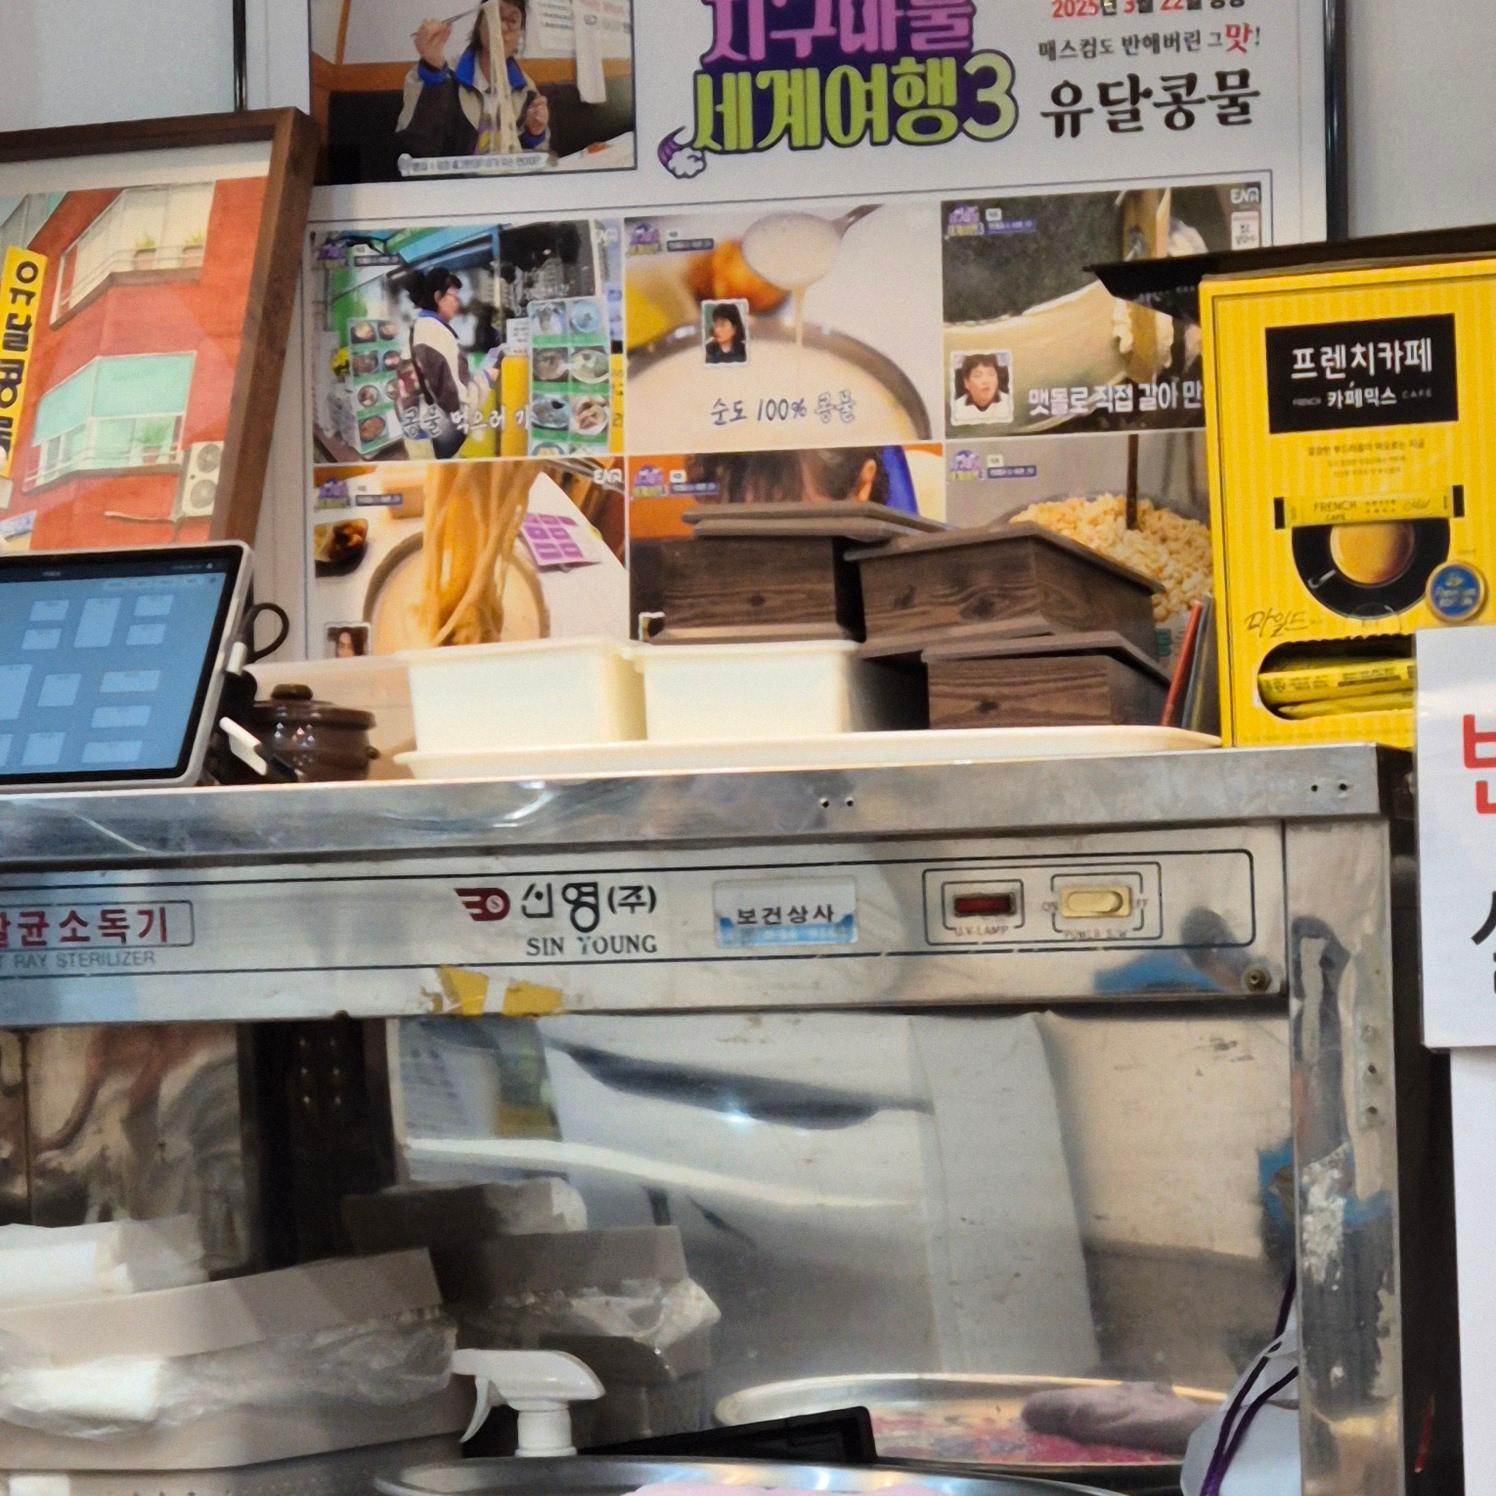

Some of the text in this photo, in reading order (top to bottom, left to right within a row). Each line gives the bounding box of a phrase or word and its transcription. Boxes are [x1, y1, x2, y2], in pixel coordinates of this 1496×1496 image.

[1038, 37, 1115, 62] 매스컴도
[692, 51, 1017, 151] 세계여행3
[1040, 68, 1261, 138] 유달콩물
[1291, 337, 1433, 380] 프렌치카페
[710, 398, 748, 426] 순도
[757, 397, 807, 422] 100%
[1029, 386, 1089, 416] 맷돌로
[1094, 383, 1134, 413] 직접
[521, 881, 657, 933] 신영(주)
[736, 903, 835, 926] 보건상사
[14, 954, 48, 969] RAY
[56, 950, 156, 969] STERILIZER
[526, 935, 658, 957] SIN YOUNG
